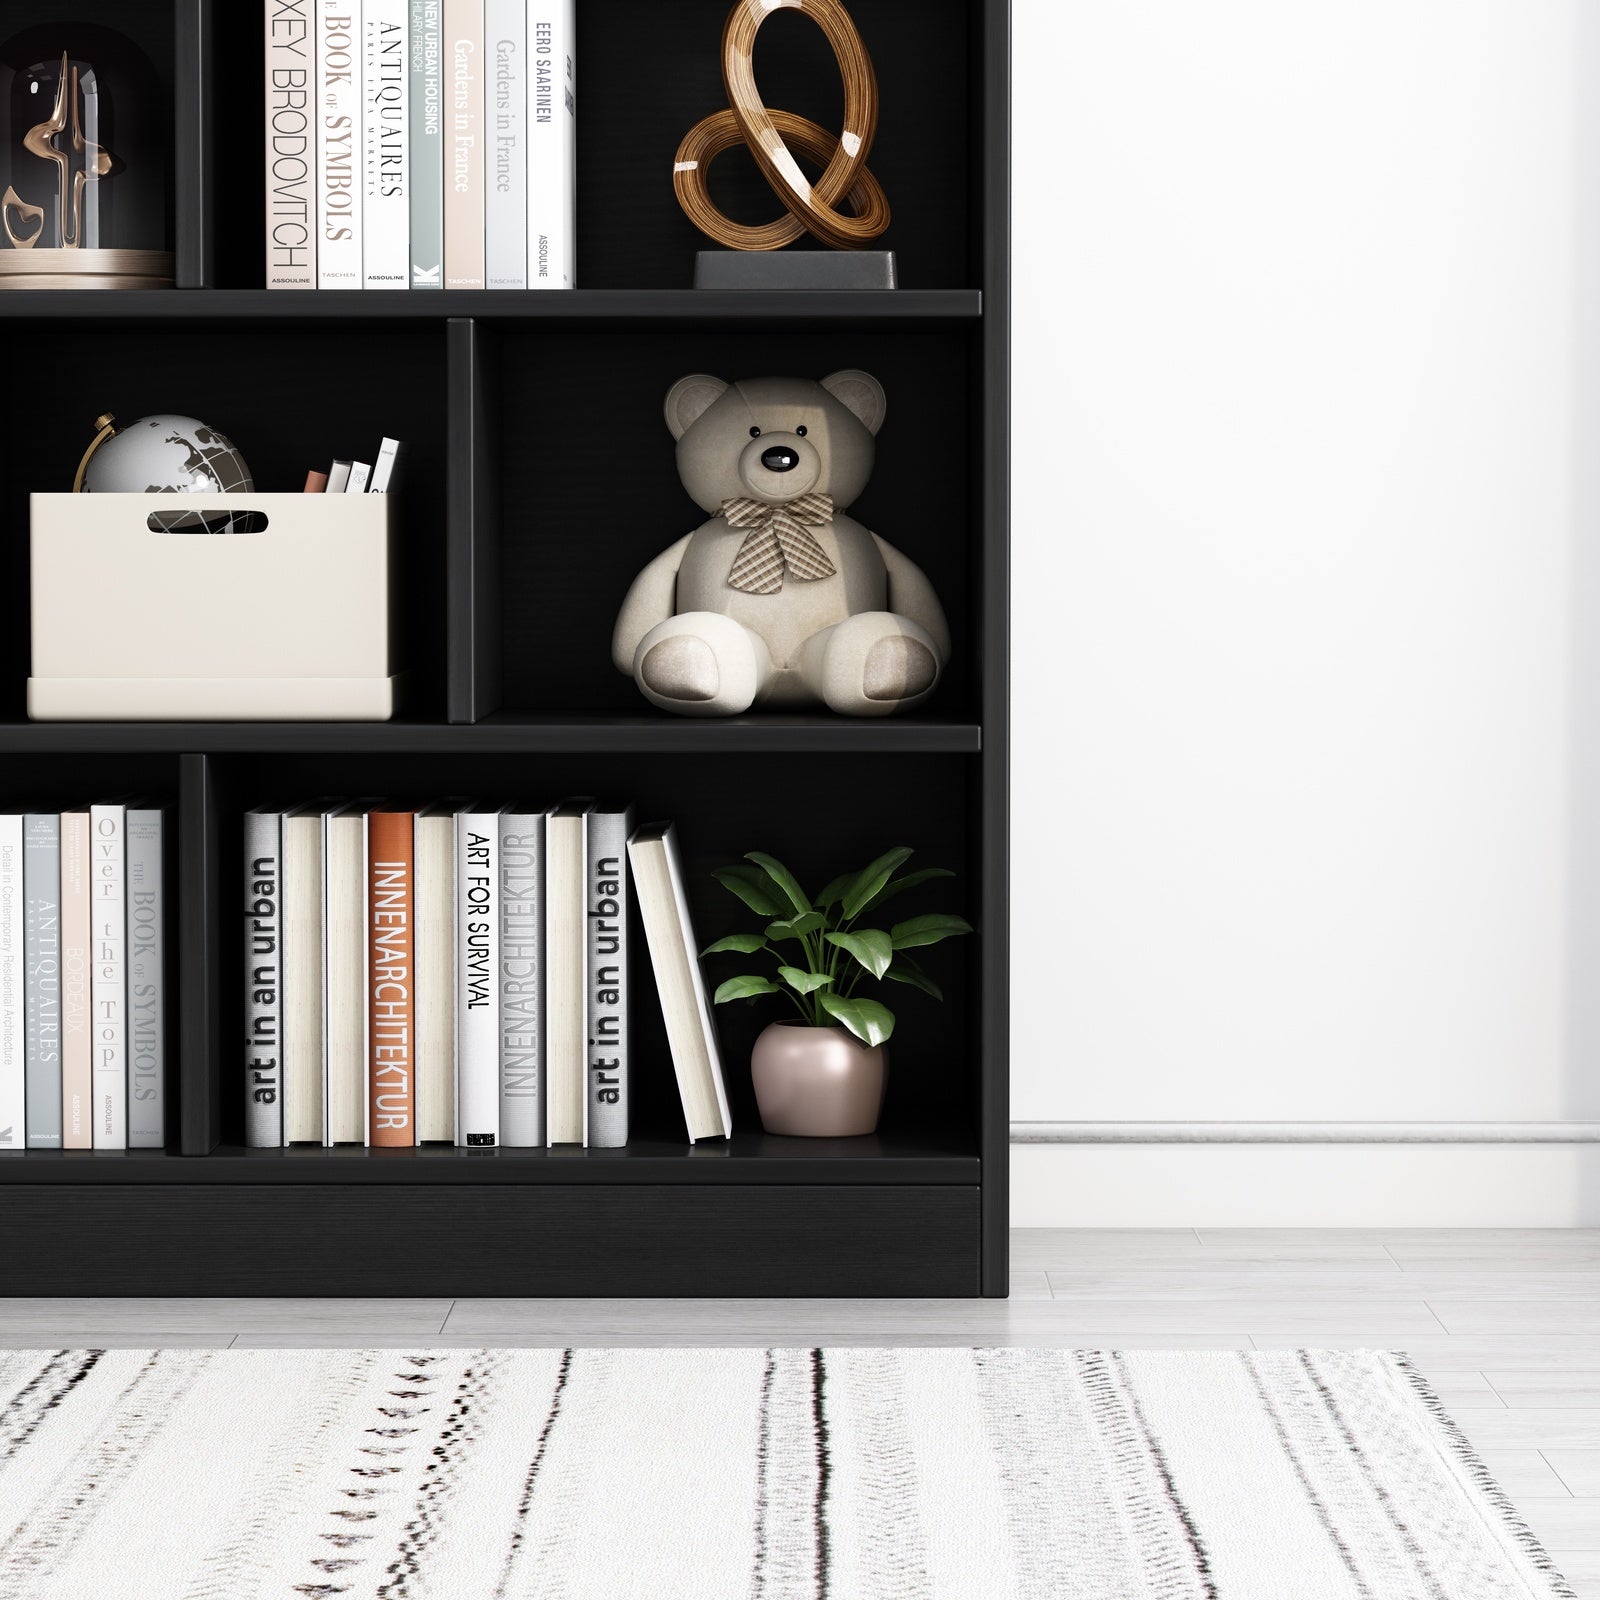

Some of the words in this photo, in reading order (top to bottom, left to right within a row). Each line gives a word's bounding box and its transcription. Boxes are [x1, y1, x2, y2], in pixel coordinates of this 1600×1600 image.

[412, 1, 423, 33] HILARY
[424, 1, 438, 29] NEW
[536, 22, 551, 54] EERO
[325, 16, 352, 87] BOOK
[412, 36, 423, 72] FRENCH
[424, 33, 438, 75] URBAN
[455, 39, 475, 109] Gardens
[496, 39, 516, 109] Gardens
[325, 93, 337, 109] OF
[375, 22, 403, 197] ANTIQUAIRES
[424, 79, 438, 135] HOUSING
[536, 59, 551, 123] SAARINEN
[455, 115, 475, 130] in
[496, 114, 516, 130] in
[272, 69, 308, 267] BRODOVITCH
[325, 116, 353, 241] SYMBOLS
[367, 127, 375, 196] MARKETS
[455, 135, 475, 192] France
[496, 135, 516, 192] France
[538, 235, 548, 277] ASSOULINE
[2, 846, 13, 872] Detail
[133, 862, 144, 885] THE
[467, 832, 490, 868] ART
[2, 886, 14, 953] Contemporary
[245, 857, 276, 954] urban
[467, 876, 490, 916] FOR
[588, 857, 620, 954] urban
[133, 891, 156, 956] BOOK
[3, 956, 14, 1006] Residential
[35, 899, 58, 1062] ANTIQUAIRES
[66, 948, 85, 1033] BORDEAUX
[134, 963, 145, 978] OF
[253, 966, 276, 1005] an
[467, 922, 490, 1010] SURVIVAL
[503, 833, 536, 1099] INNENARCHITEKTUR
[597, 966, 620, 1005] an
[374, 862, 409, 1129] INNENARCHITEKTUR
[3, 1009, 14, 1065] Architecture
[134, 984, 157, 1101] SYMBOLS
[246, 1015, 276, 1046] in
[589, 1014, 620, 1046] in
[250, 1057, 277, 1104] art
[593, 1057, 620, 1104] art
[72, 1095, 80, 1136] ASSOULINE
